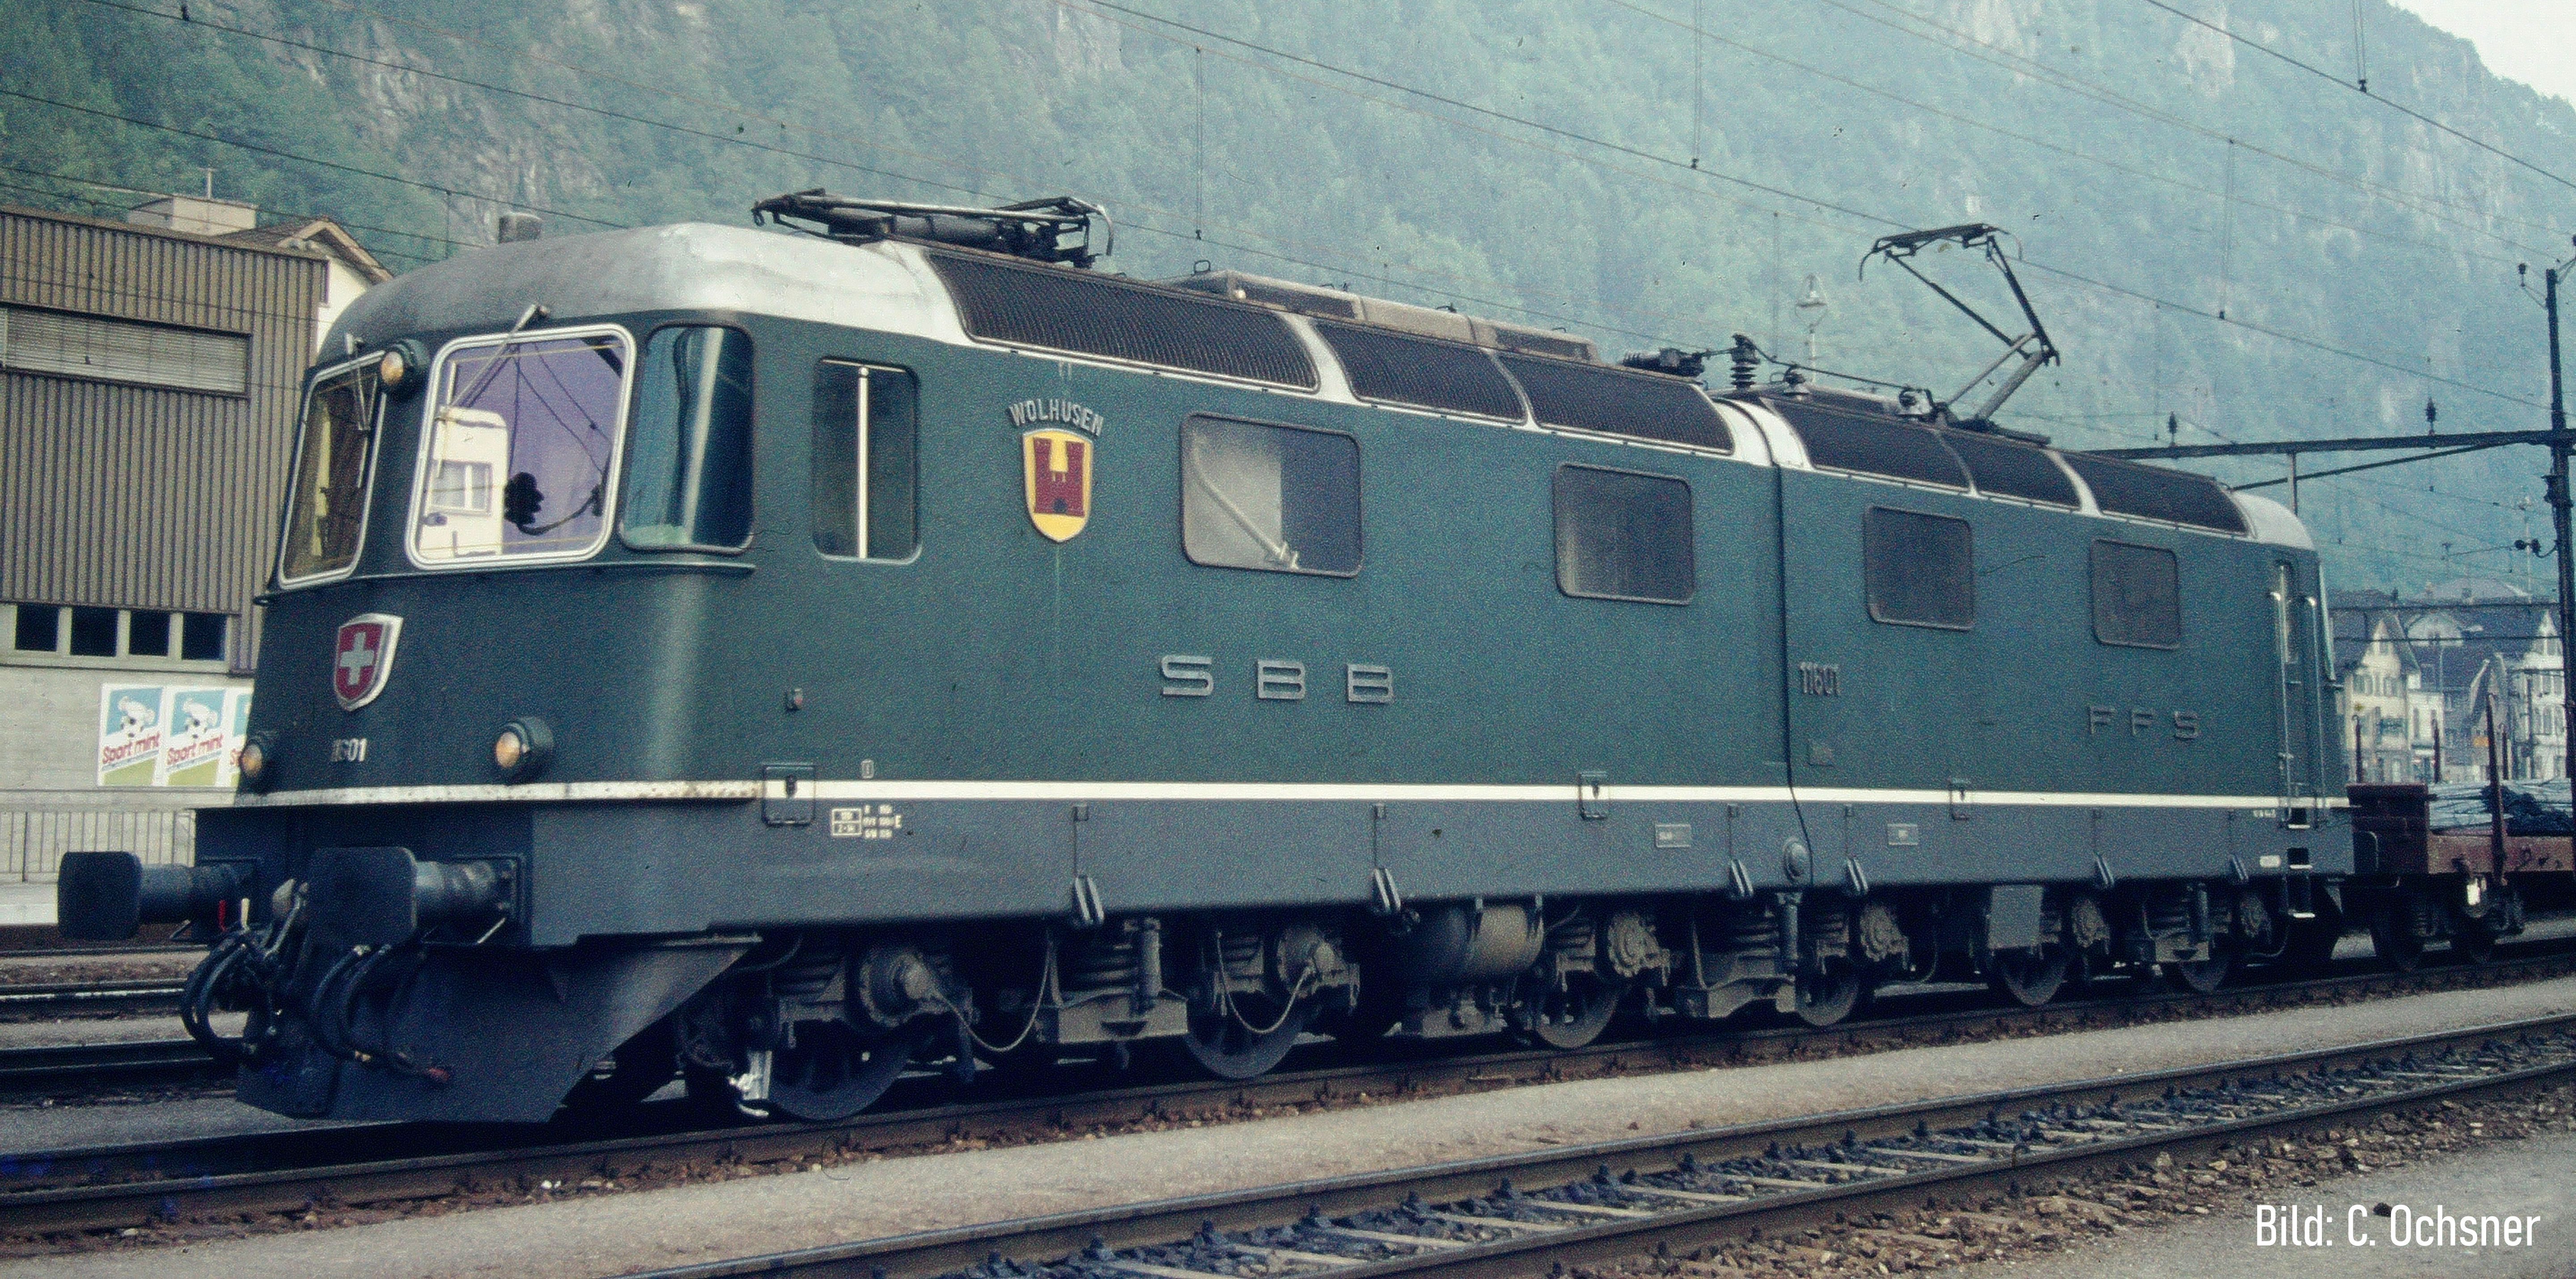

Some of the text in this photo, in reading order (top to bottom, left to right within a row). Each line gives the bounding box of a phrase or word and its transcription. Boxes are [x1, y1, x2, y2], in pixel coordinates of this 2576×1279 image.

[1008, 398, 1104, 437] WOLHUSEN
[102, 742, 133, 764] Sport
[136, 731, 160, 754] mint
[167, 743, 196, 765] Sport
[199, 733, 224, 755] mint
